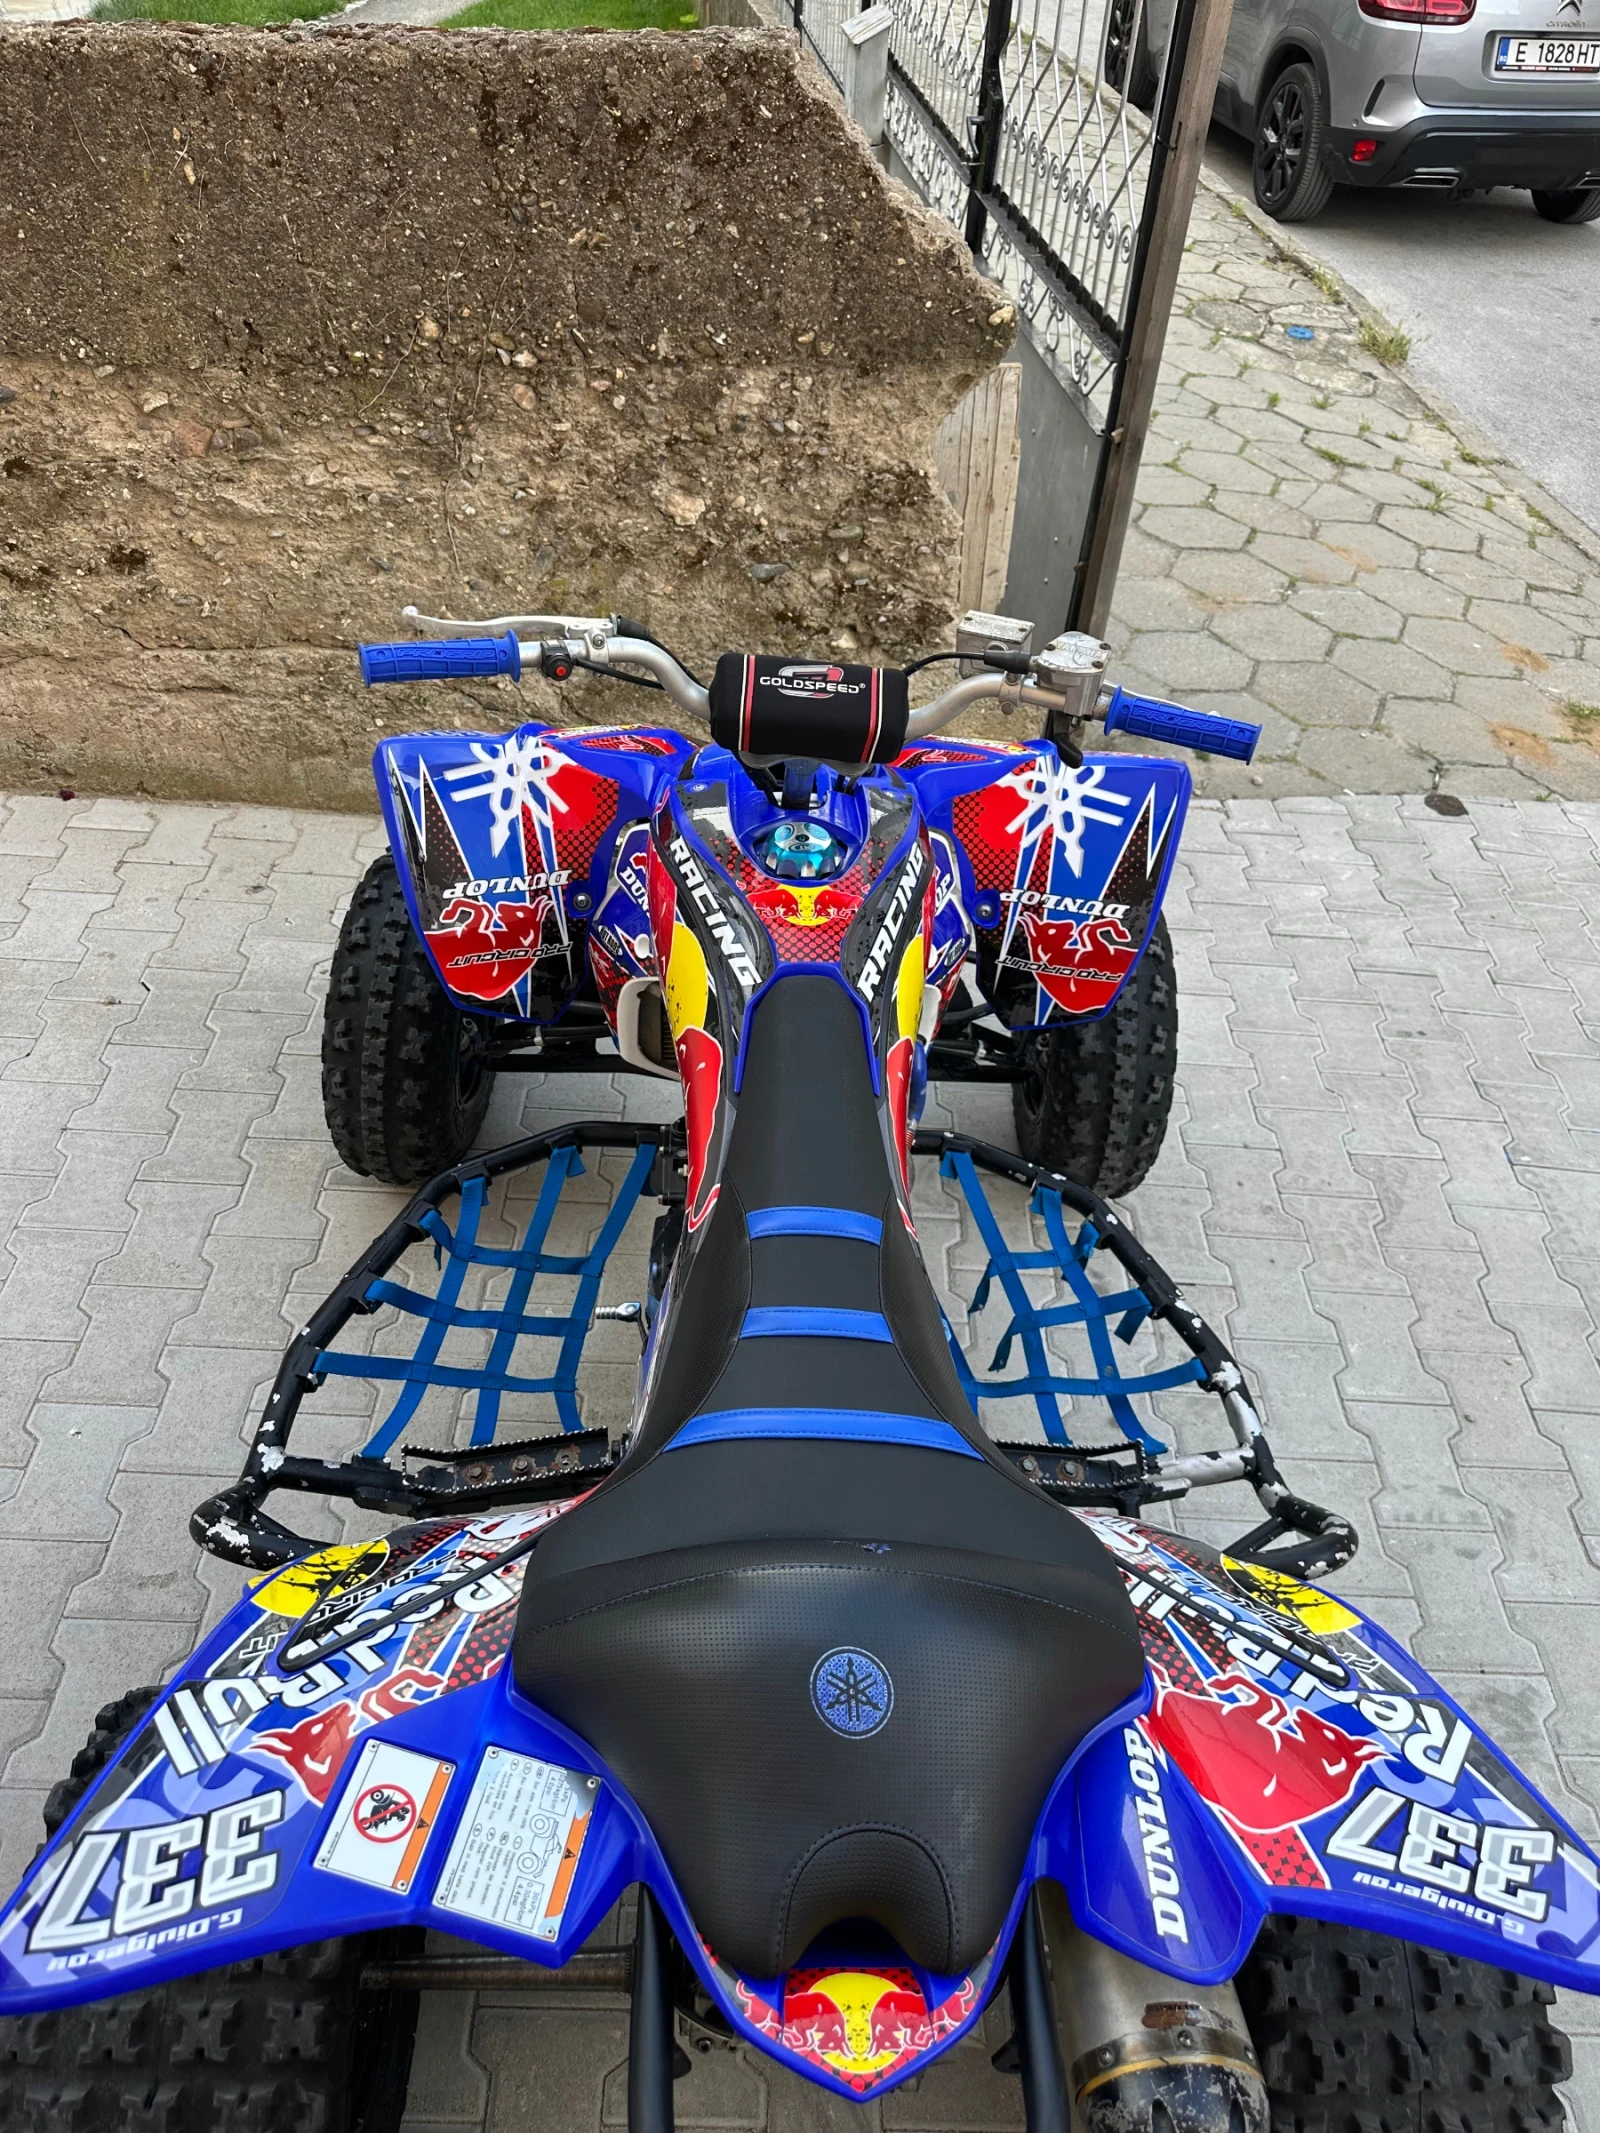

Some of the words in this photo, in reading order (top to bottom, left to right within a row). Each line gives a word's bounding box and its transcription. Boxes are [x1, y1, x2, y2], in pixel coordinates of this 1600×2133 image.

[1515, 42, 1528, 62] E
[1538, 42, 1575, 63] 1828
[1576, 43, 1600, 64] HT
[397, 648, 496, 659] PROGRIP
[1056, 640, 1101, 659] YAMAHA
[1133, 706, 1229, 732] PROGRIP
[443, 869, 573, 899] DUNLOP
[620, 866, 649, 909] DUN
[1000, 888, 1131, 919] DUNLOP
[670, 835, 763, 986] RACING
[857, 841, 923, 1003] RACING
[446, 948, 531, 969] CIRCUIT
[531, 942, 573, 958] PRO
[995, 955, 1077, 977] CIRCUIT
[1076, 967, 1125, 983] PRO
[386, 1549, 458, 1591] PRO
[334, 1556, 521, 1676] Red
[153, 1638, 347, 1779] Bull
[1289, 1654, 1473, 1787] Red
[1124, 1726, 1188, 1944] DUNLOP
[1326, 1786, 1556, 1922] 337
[27, 1789, 285, 1952] 337
[1352, 1871, 1526, 1936] G.Diulgerov
